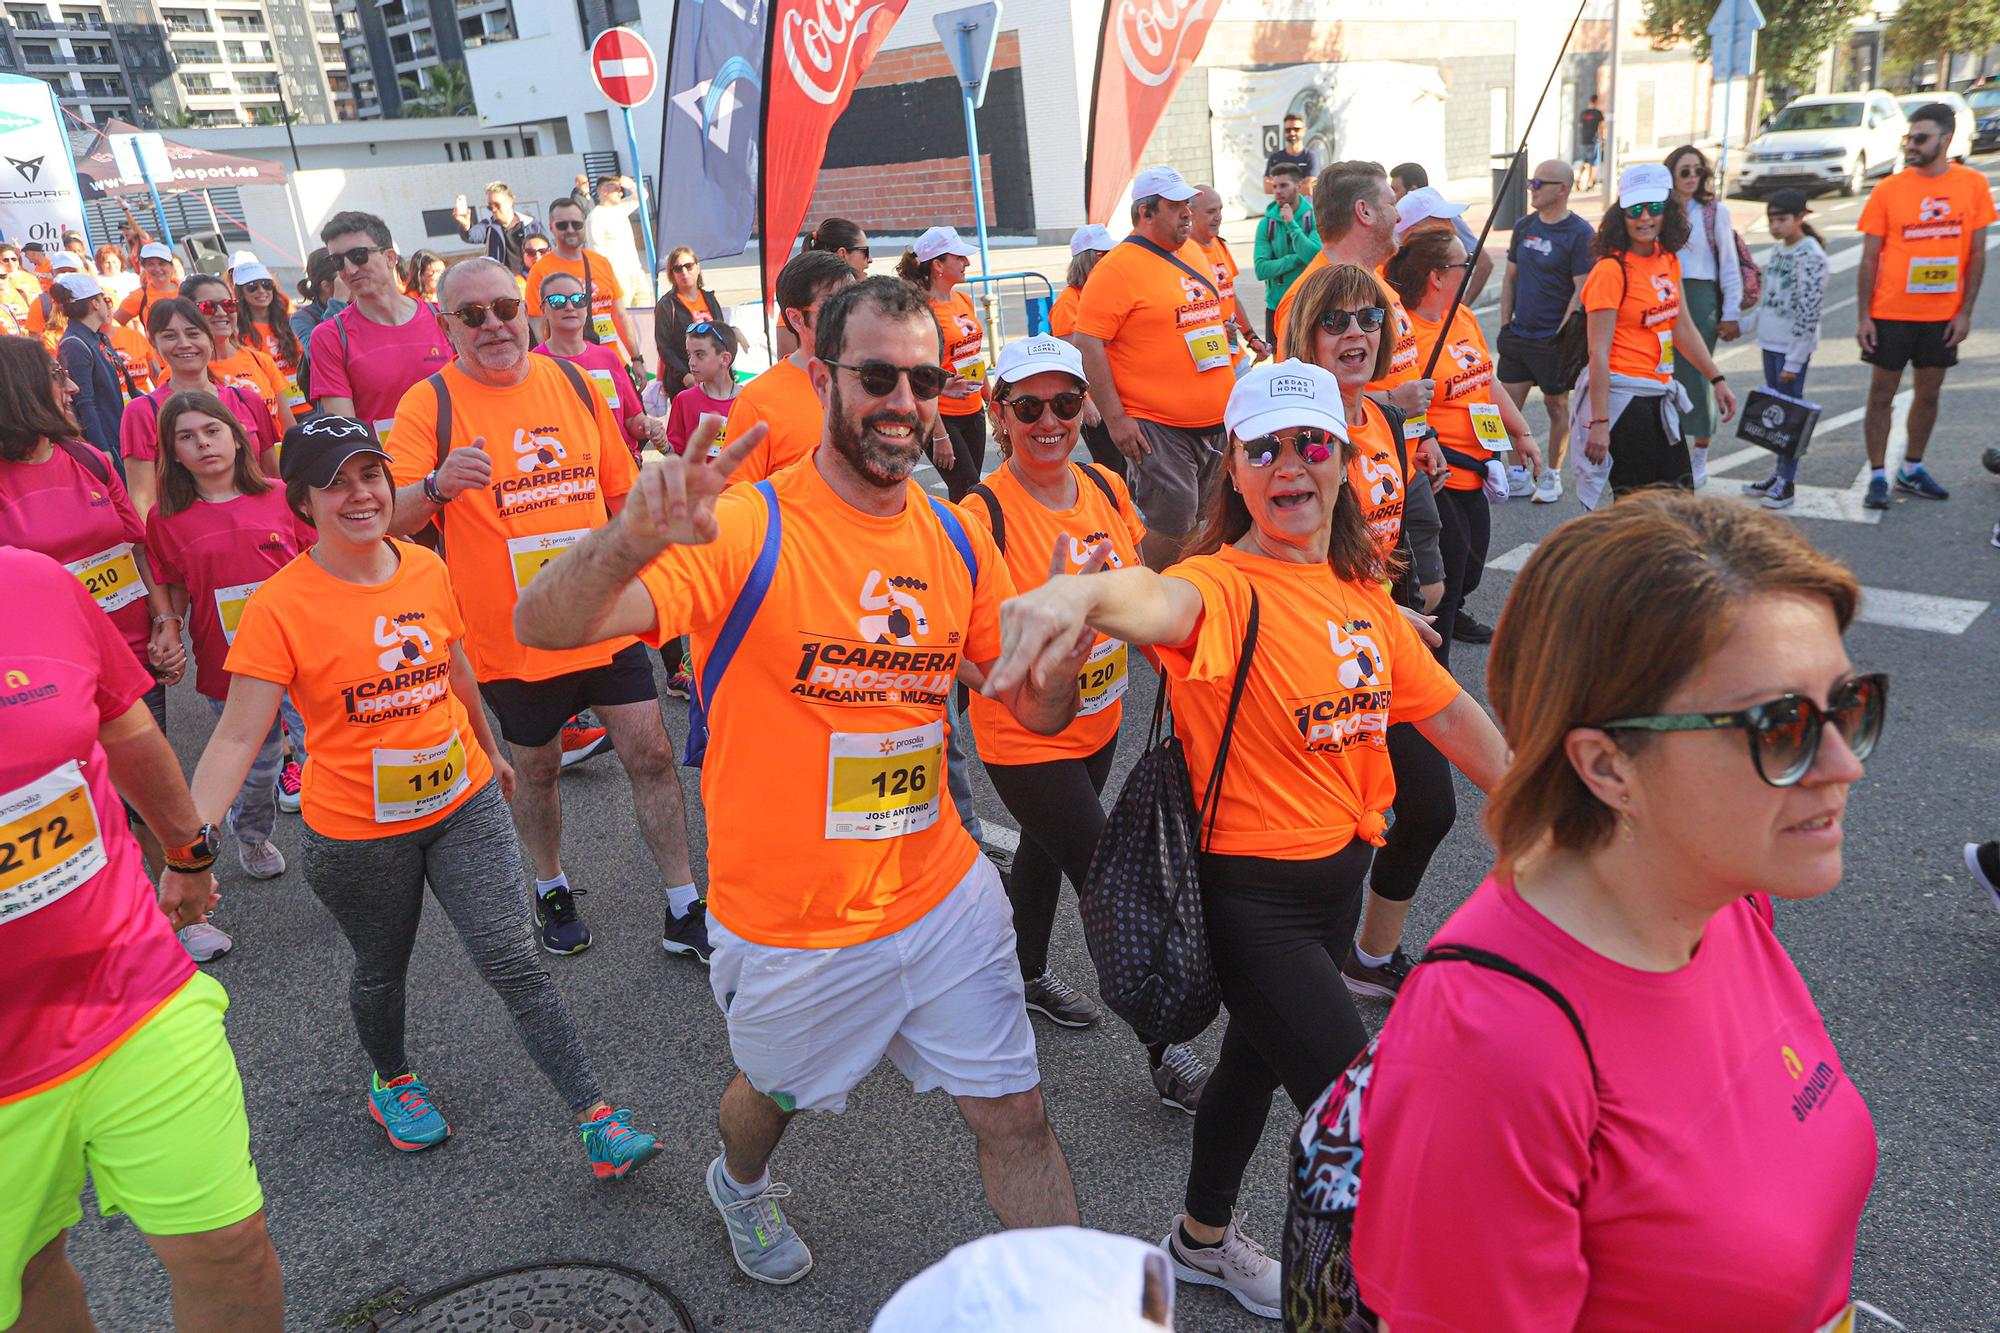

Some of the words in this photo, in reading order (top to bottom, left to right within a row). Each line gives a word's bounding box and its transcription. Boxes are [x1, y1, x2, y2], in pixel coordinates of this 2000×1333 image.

[0, 190, 70, 199] CUPRA
[1181, 299, 1221, 314] CARRERA
[1206, 340, 1219, 352] 59
[970, 368, 977, 378] 4
[1277, 379, 1308, 387] AEDAS
[1453, 360, 1493, 385] CARRER
[1277, 385, 1309, 393] HOMES
[492, 482, 503, 509] 1
[503, 465, 596, 492] CARRERA
[503, 479, 597, 507] PROSOLIA
[499, 497, 558, 519] ALICANTE
[85, 567, 118, 594] 210
[795, 643, 820, 681] 1
[819, 644, 957, 673] CARRERA
[809, 666, 950, 692] PROSOLIA
[1078, 662, 1115, 690] 120
[341, 686, 356, 714] 1
[791, 683, 886, 703] ALICANTE
[347, 703, 422, 724] ALICANTE
[1312, 690, 1392, 721] CARRER
[896, 735, 925, 750] prosolia
[408, 762, 453, 793] 110
[871, 764, 926, 799] 126
[416, 793, 441, 806] Patata
[893, 802, 930, 817] ANTONIO
